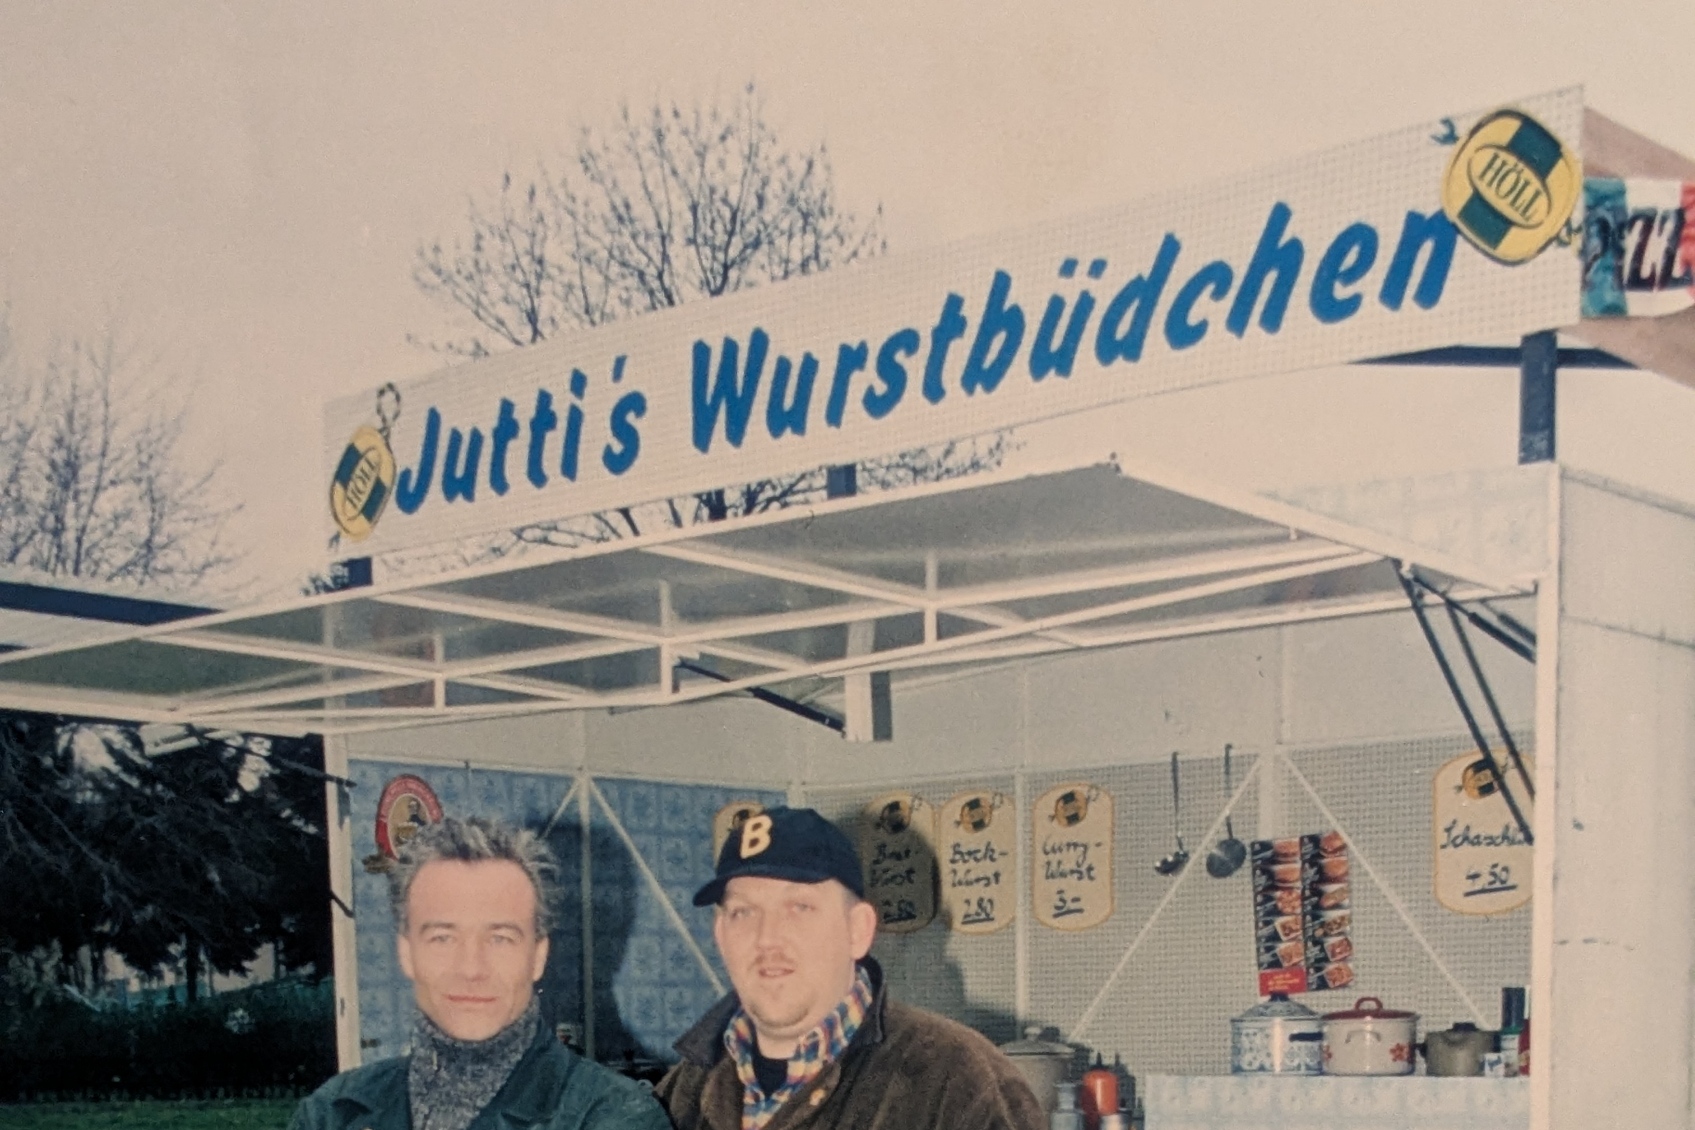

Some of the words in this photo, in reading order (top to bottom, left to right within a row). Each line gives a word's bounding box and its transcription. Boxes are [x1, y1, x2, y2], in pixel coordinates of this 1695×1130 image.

[1477, 151, 1545, 223] HÖLL
[396, 356, 646, 513] Jutti's
[691, 202, 1461, 451] Wurstbüdchen
[740, 814, 772, 860] B
